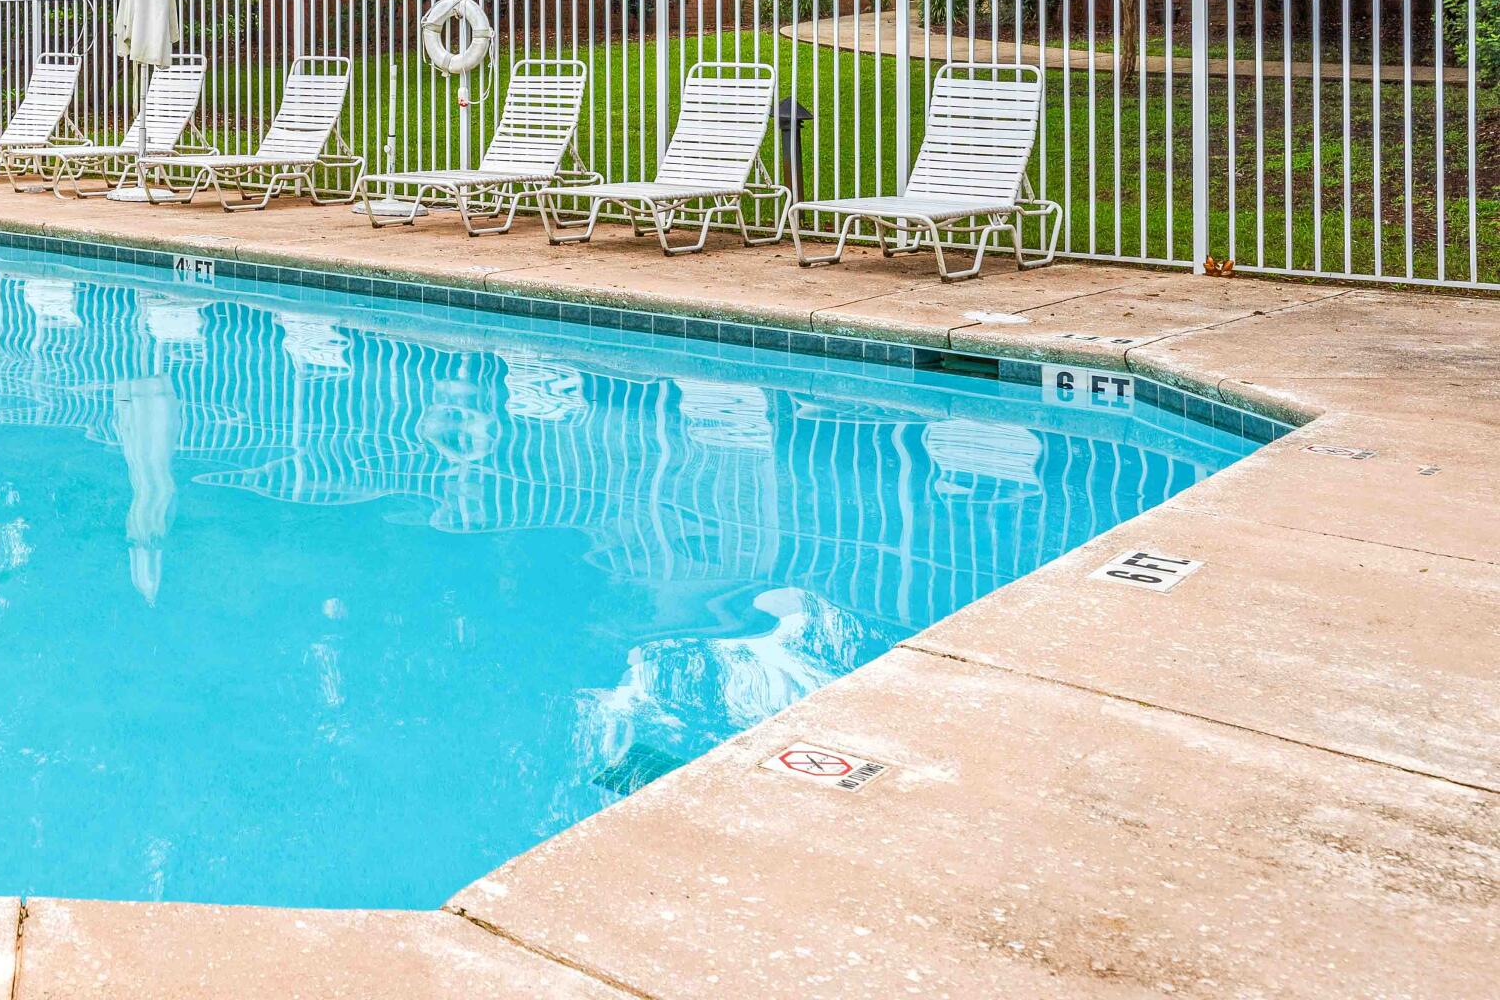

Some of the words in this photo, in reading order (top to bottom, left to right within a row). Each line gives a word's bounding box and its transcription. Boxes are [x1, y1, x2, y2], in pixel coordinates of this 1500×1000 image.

[1056, 371, 1075, 391] 6
[1106, 570, 1163, 583] 6
[836, 780, 859, 790] NO
[848, 763, 884, 781] DIVING
